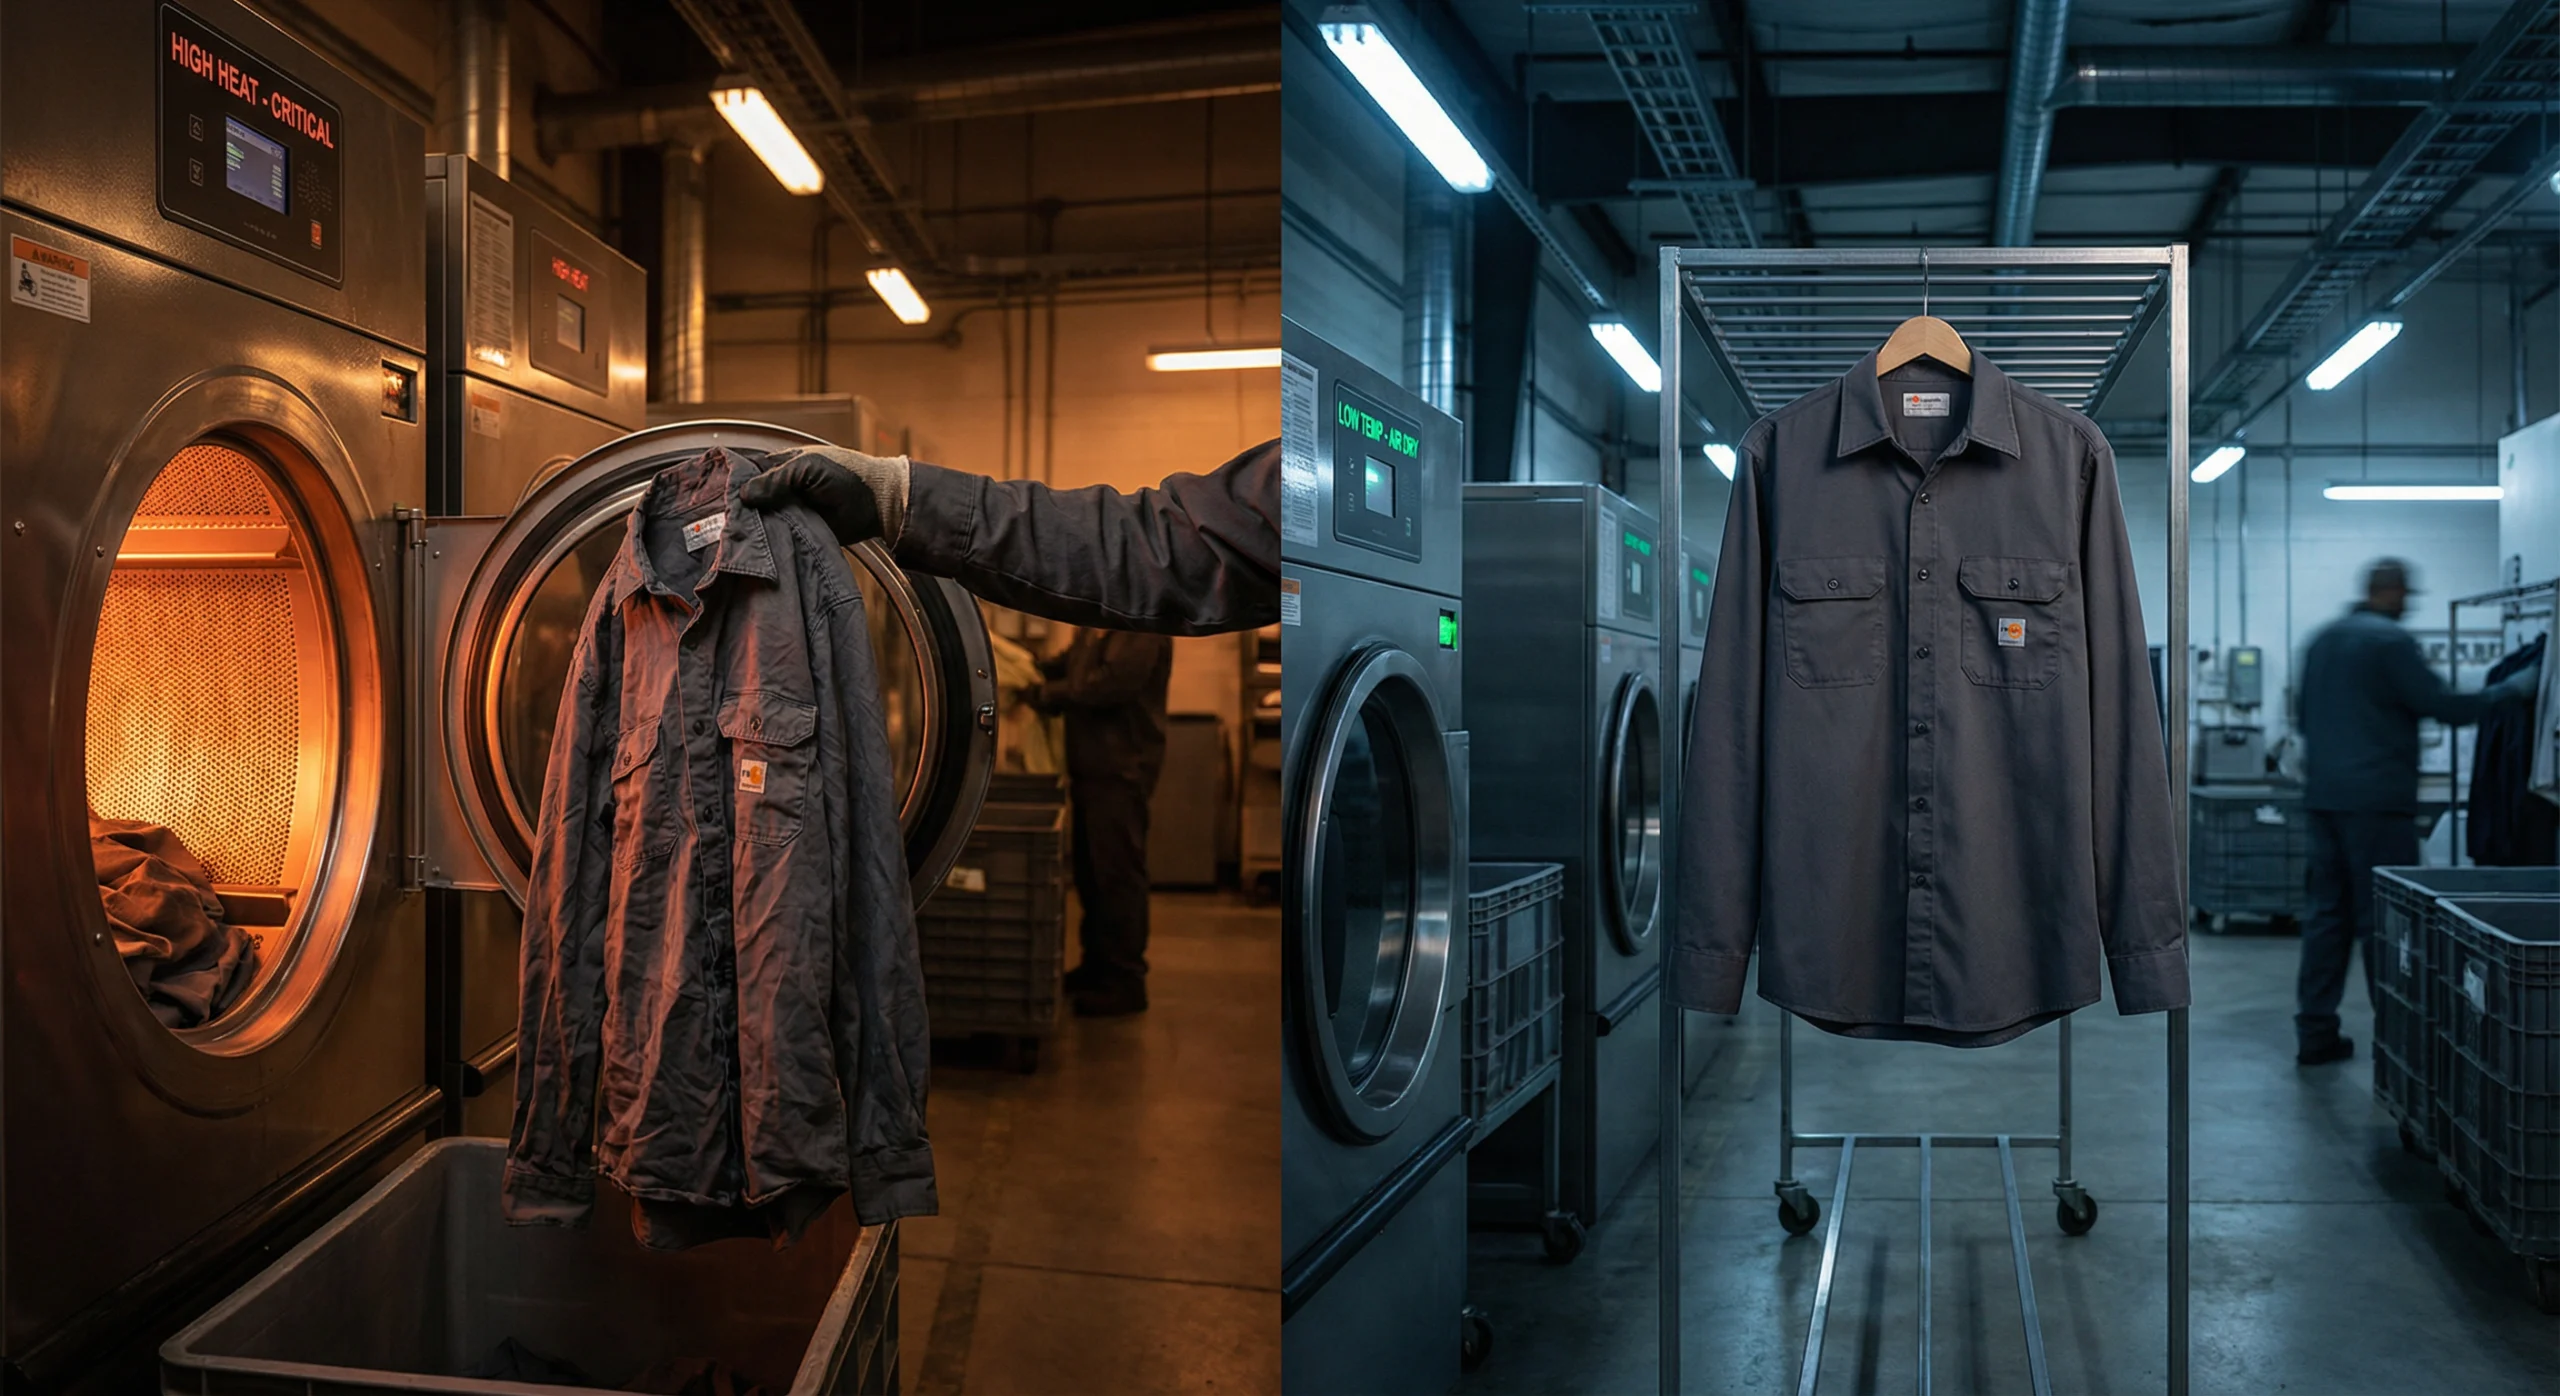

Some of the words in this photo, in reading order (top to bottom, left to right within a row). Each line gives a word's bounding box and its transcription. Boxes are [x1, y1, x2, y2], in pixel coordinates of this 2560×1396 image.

[171, 31, 213, 82] HIGH
[218, 58, 259, 106] HEAT
[271, 91, 334, 149] CRITICAL
[1338, 401, 1360, 432] LOW
[1360, 411, 1384, 442] TEMP
